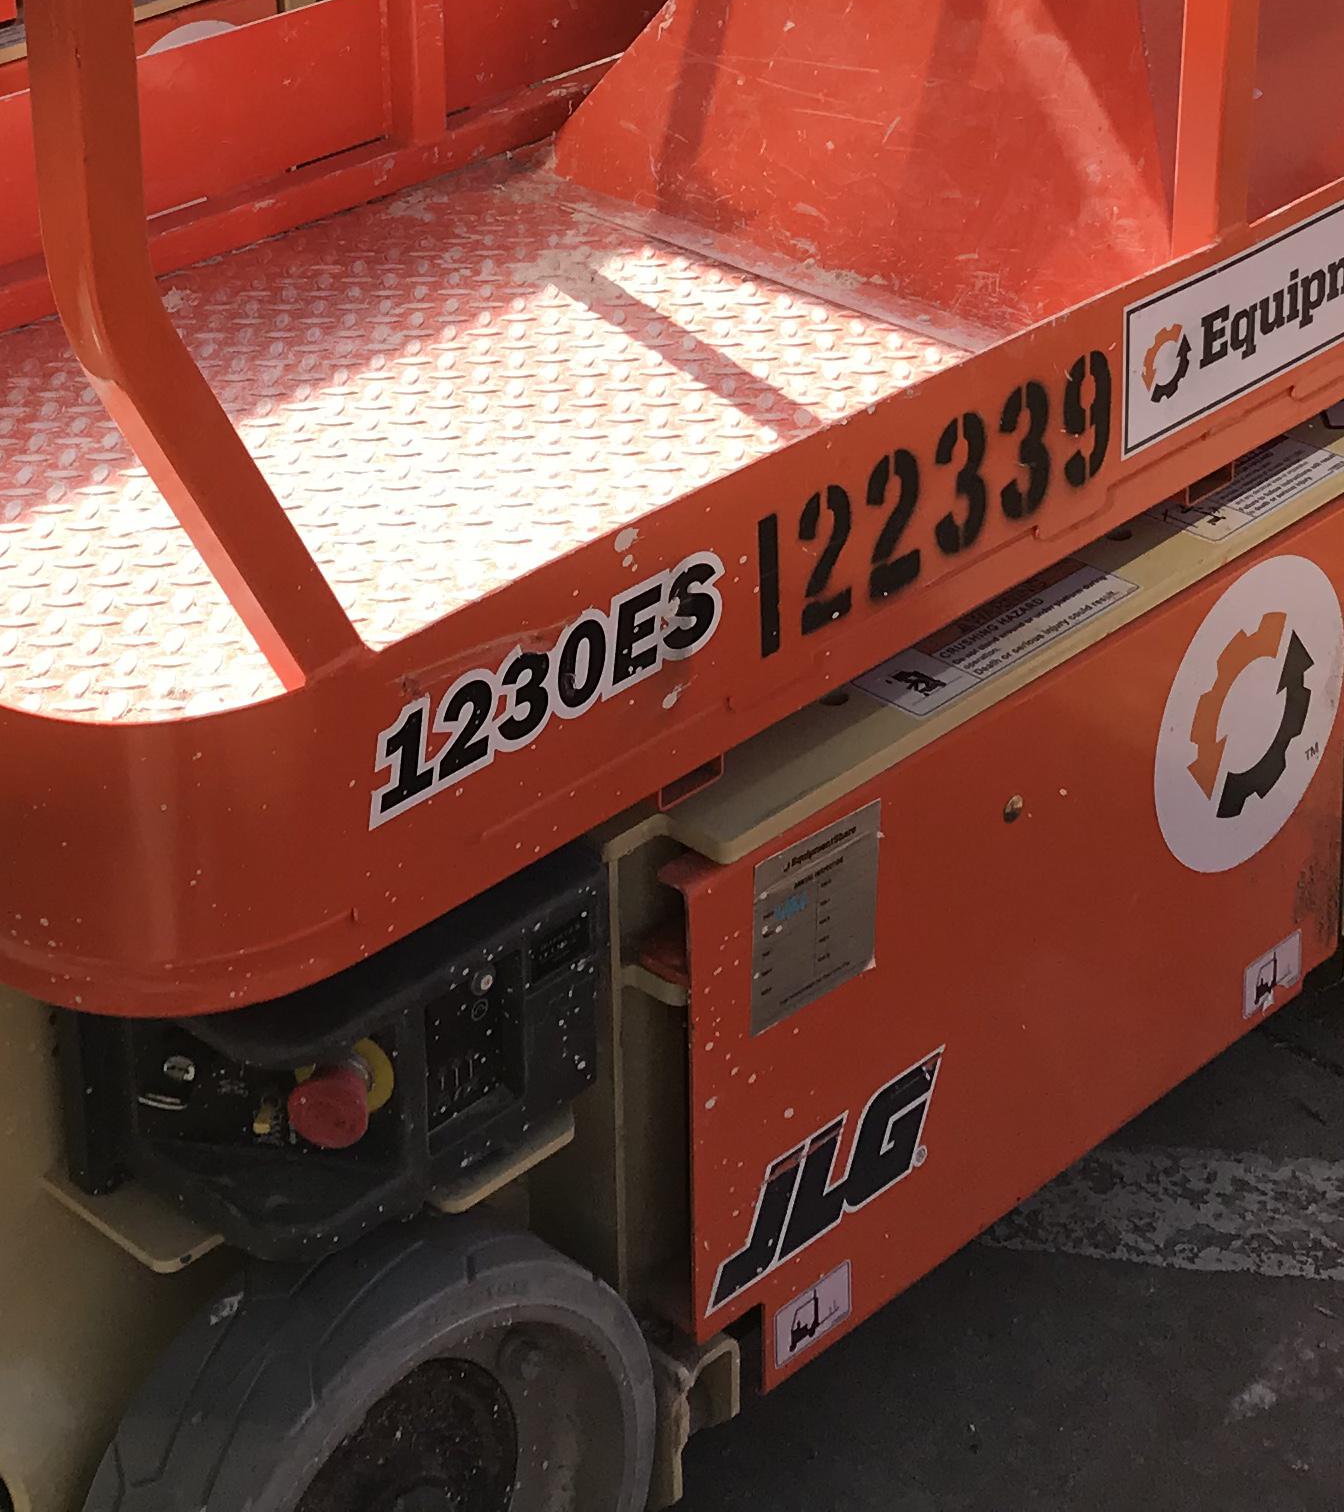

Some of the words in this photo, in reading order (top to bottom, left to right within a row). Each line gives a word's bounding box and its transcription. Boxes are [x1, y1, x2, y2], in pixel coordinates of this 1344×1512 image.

[759, 350, 1113, 658] 122339
[939, 620, 1000, 659] CRUSHING
[1000, 597, 1046, 630] HAZARD
[378, 560, 720, 818] 1230ES
[705, 1044, 945, 1318] JLG
